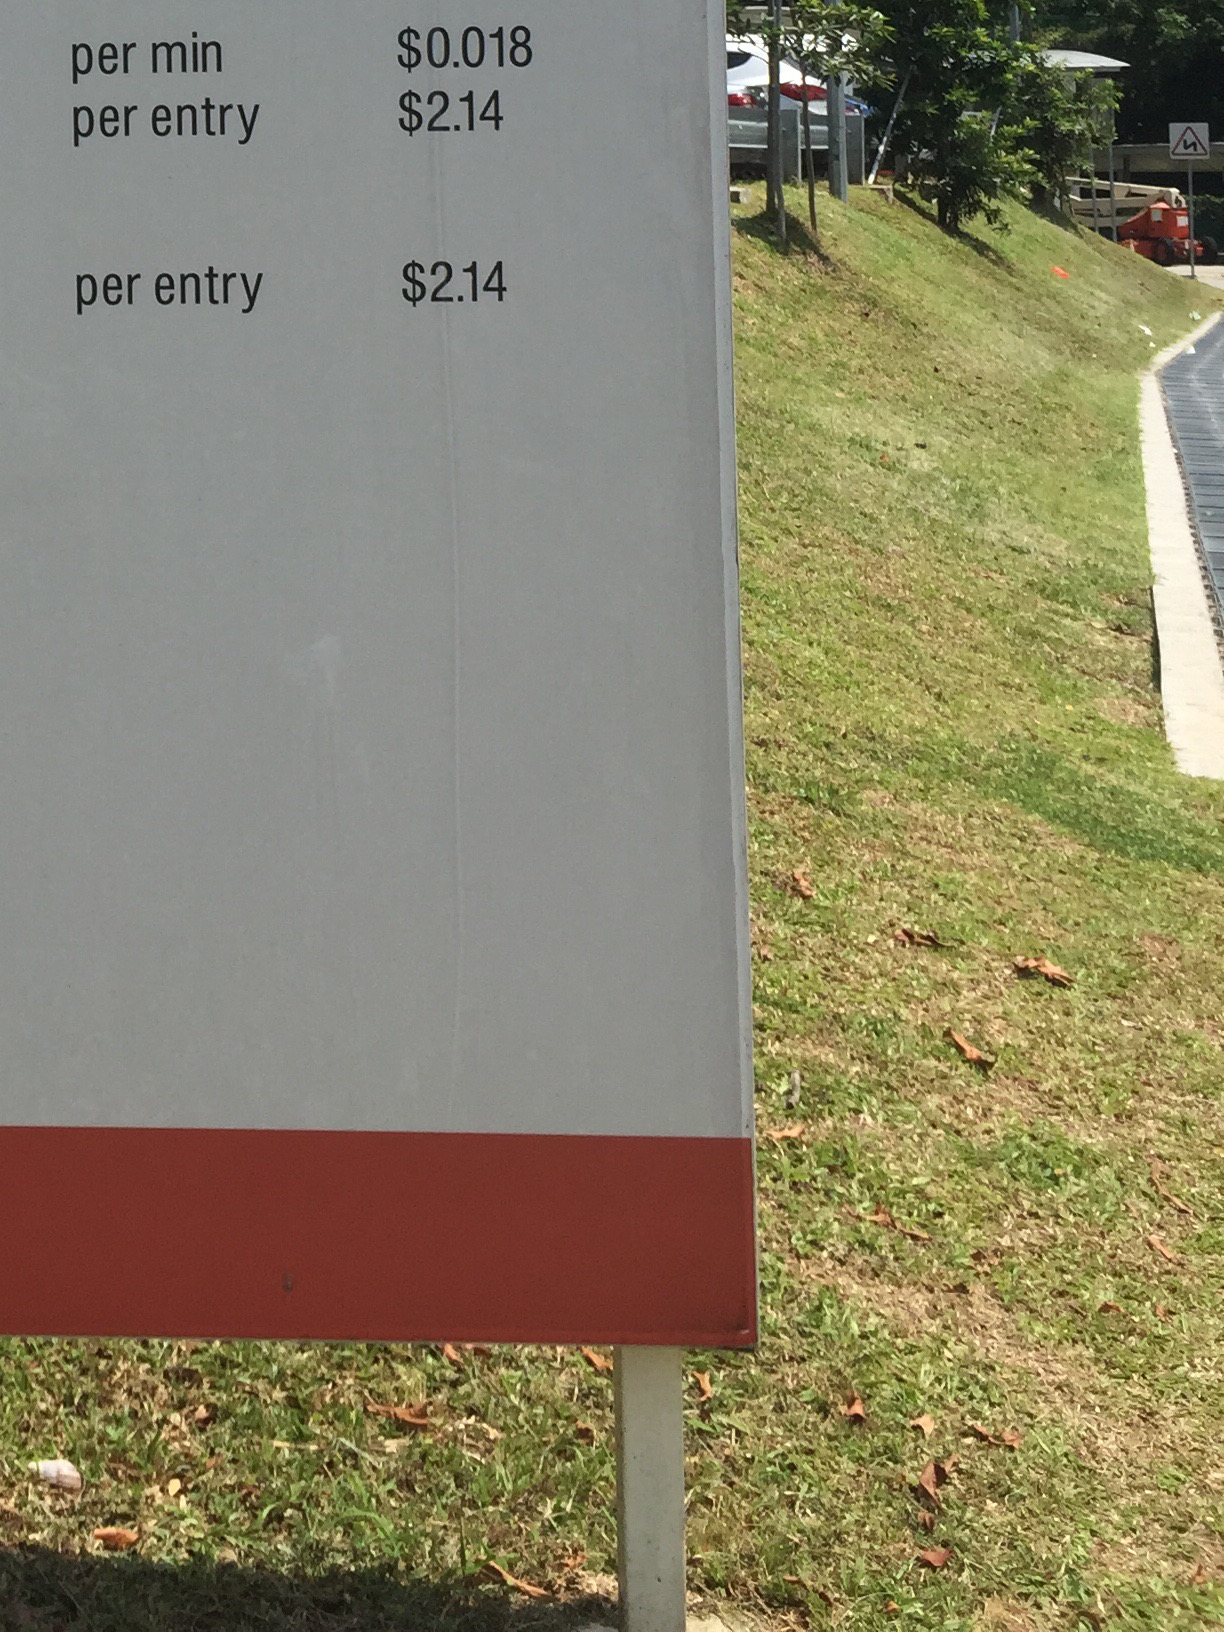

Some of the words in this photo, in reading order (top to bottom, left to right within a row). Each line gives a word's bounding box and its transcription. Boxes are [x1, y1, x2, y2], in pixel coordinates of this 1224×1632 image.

[71, 42, 137, 84] per
[151, 32, 223, 74] min
[397, 25, 533, 74] $0.018
[72, 106, 138, 148] per
[151, 97, 260, 145] entry
[398, 89, 504, 138] $2.14
[76, 272, 142, 316] per
[154, 265, 264, 314] entry
[401, 259, 508, 308] $2.14
